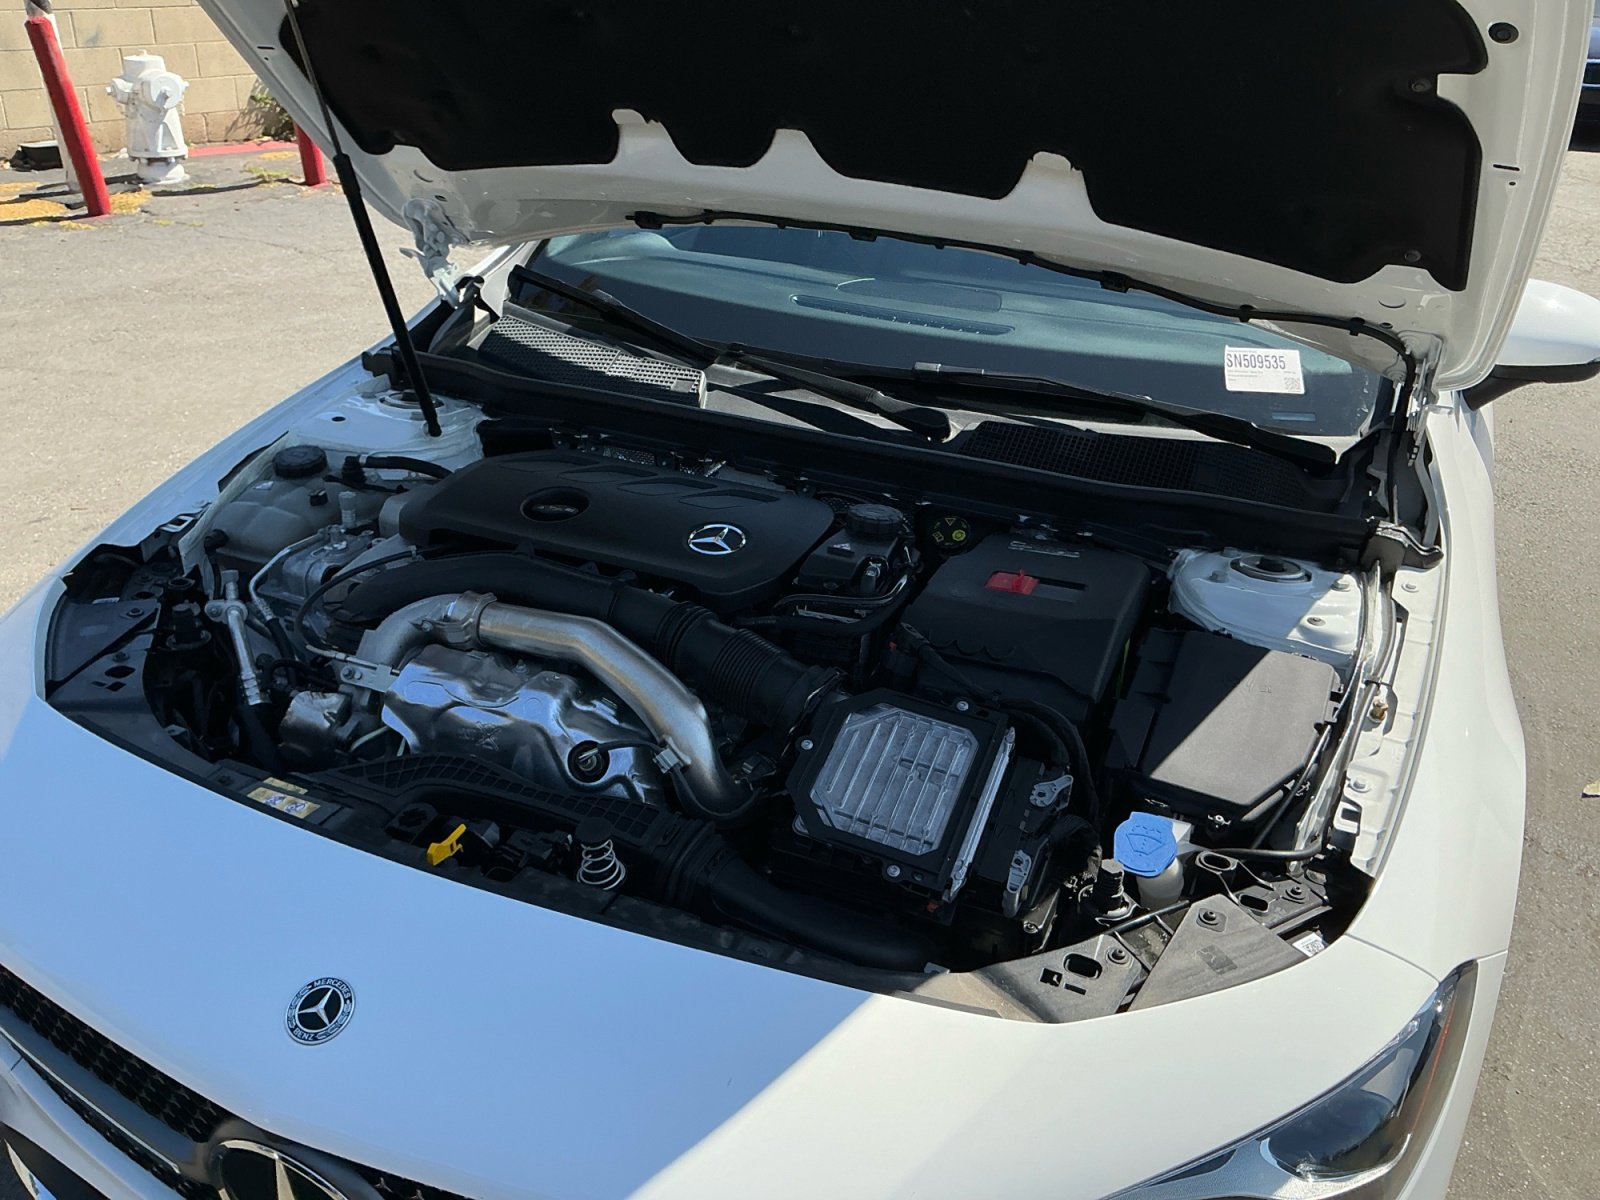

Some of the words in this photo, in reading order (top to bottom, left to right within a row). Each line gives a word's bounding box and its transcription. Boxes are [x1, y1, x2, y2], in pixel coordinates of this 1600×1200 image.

[1226, 353, 1286, 370] SN509535
[314, 979, 351, 998] MERCEDES
[293, 1028, 315, 1041] BENZ
